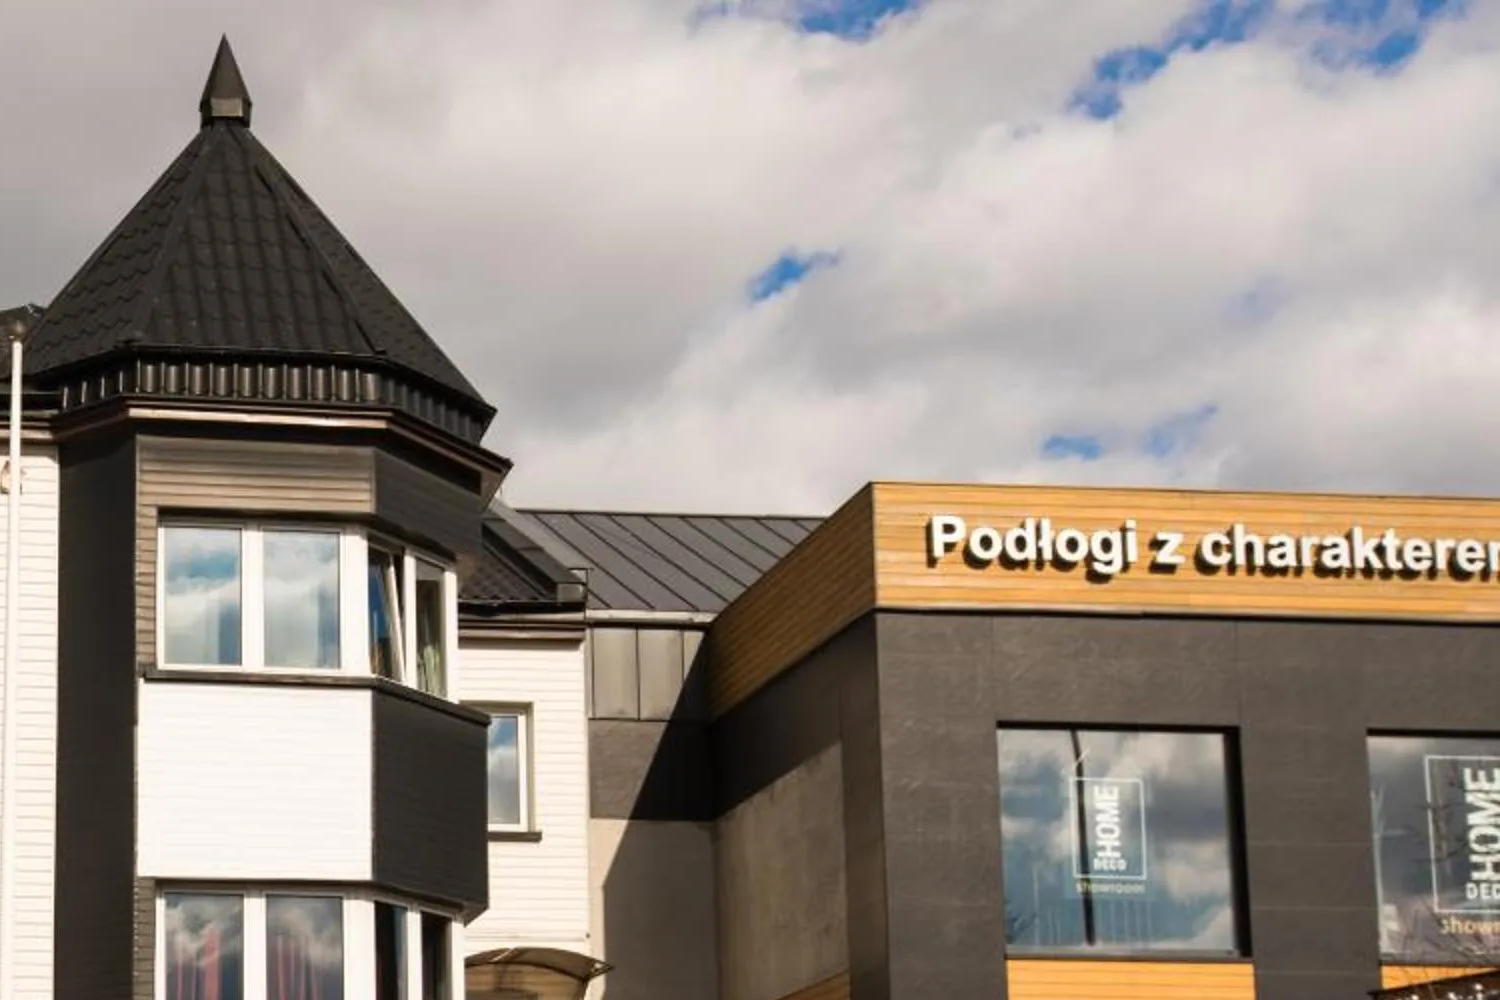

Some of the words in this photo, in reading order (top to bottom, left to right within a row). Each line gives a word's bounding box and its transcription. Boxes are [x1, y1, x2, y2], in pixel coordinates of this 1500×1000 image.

[931, 515, 1139, 574] Podłogi
[1153, 532, 1186, 565] z
[1093, 785, 1121, 858] HOME
